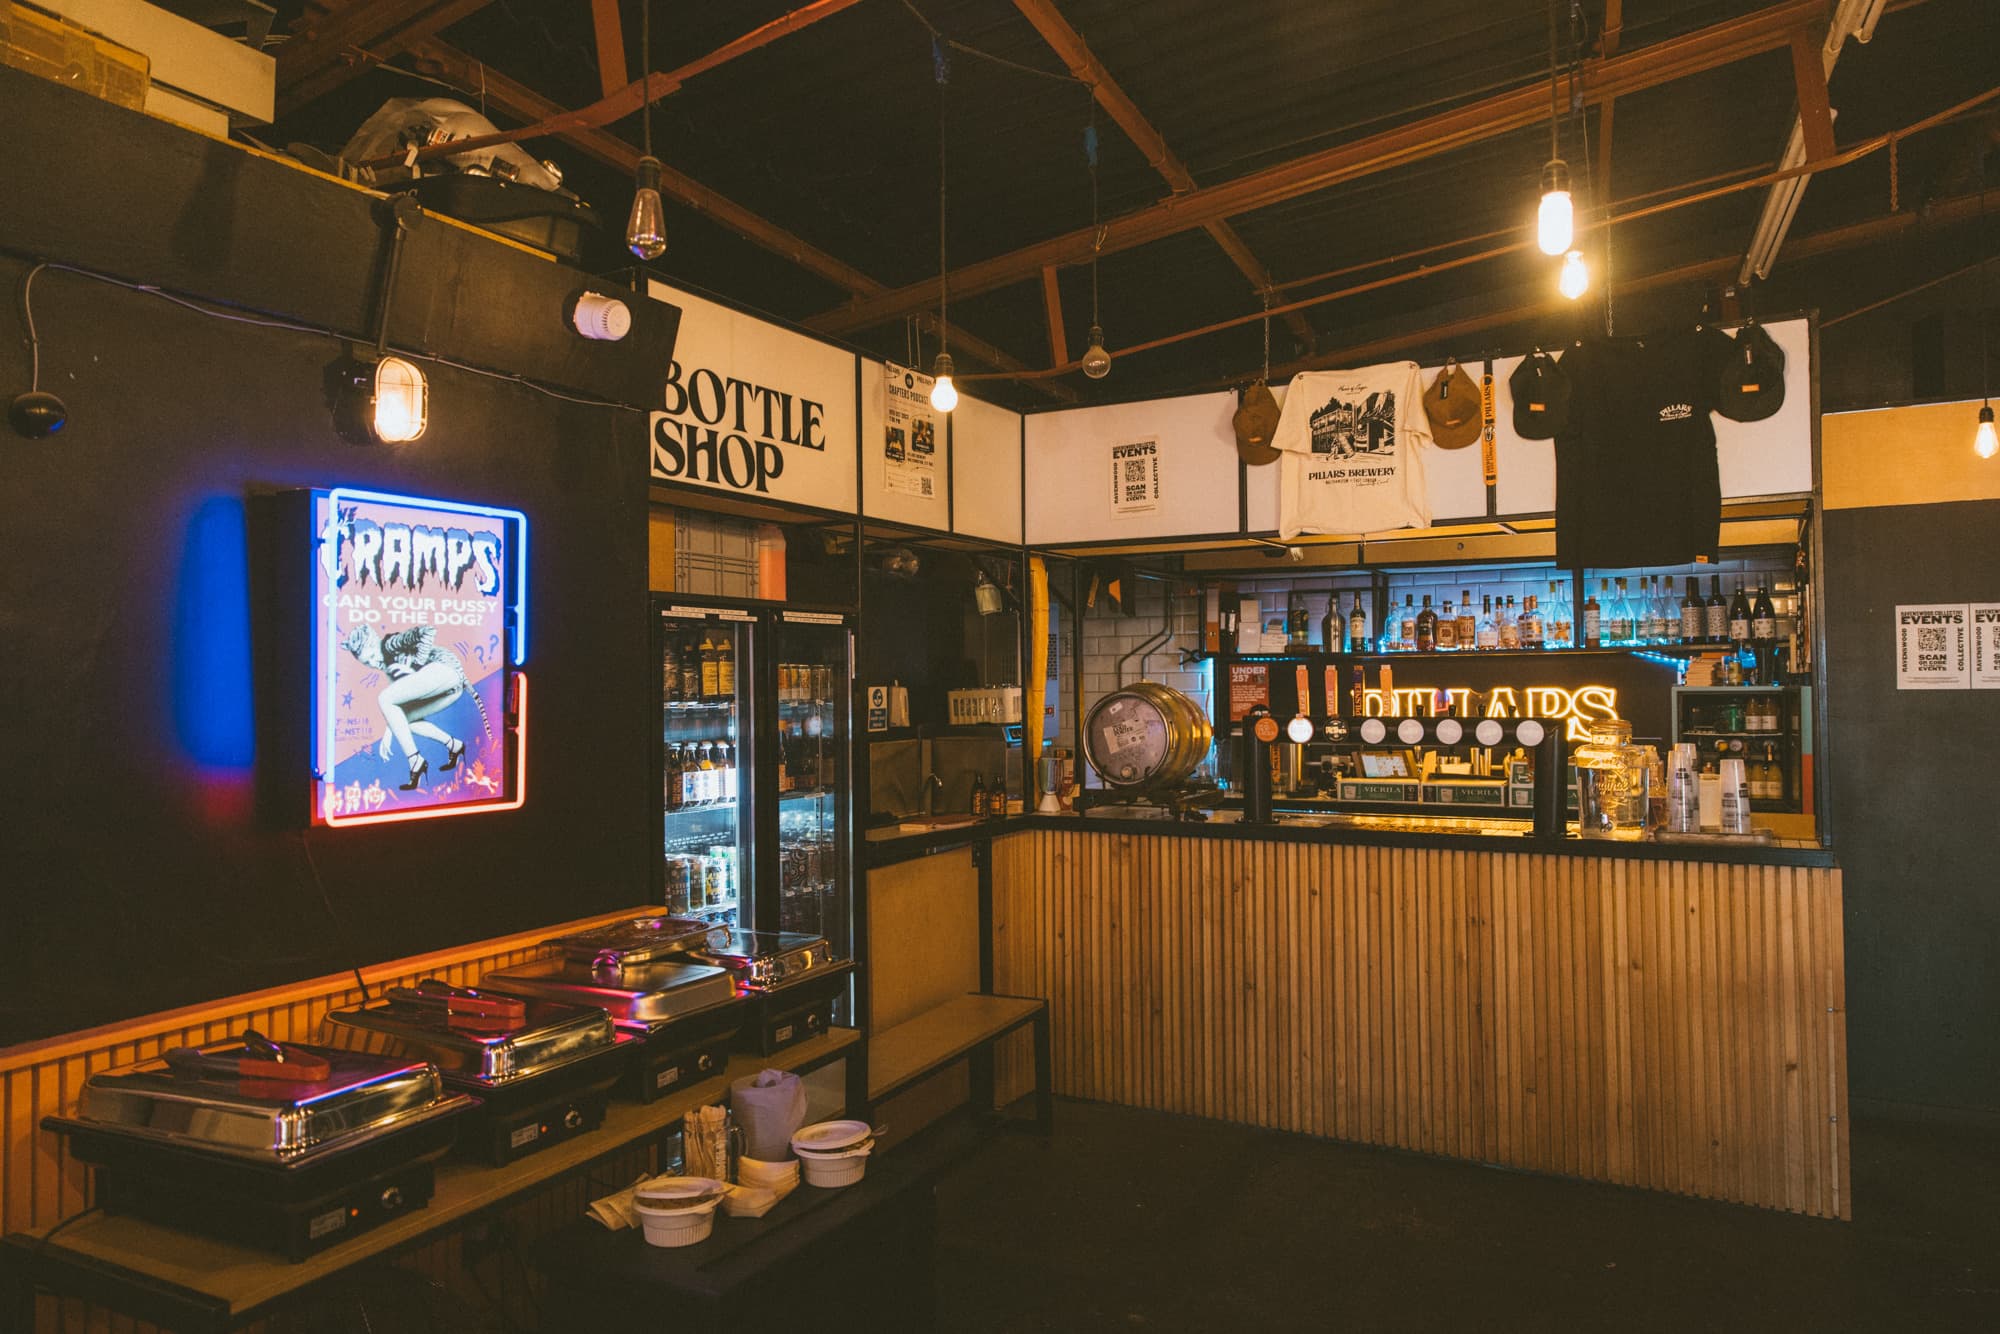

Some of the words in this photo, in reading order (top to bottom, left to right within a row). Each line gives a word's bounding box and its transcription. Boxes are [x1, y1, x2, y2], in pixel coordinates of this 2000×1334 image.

[889, 384, 910, 399] CHAPTERS
[910, 391, 929, 405] PODCAST
[664, 360, 826, 452] BOTTLE
[1660, 404, 1692, 416] PILLARS
[653, 417, 784, 493] SHOP
[1113, 446, 1157, 459] EVENTS
[1308, 469, 1346, 480] PILLARS
[1348, 467, 1397, 477] BREWERY
[1126, 484, 1146, 492] SCAN
[320, 515, 502, 597] CRAMPS
[378, 595, 436, 611] YOUR
[441, 599, 499, 614] PUSSY
[349, 609, 381, 624] DO
[387, 610, 427, 625] THE
[434, 612, 484, 627] DOG?
[1901, 615, 1963, 625] EVENTS
[1460, 788, 1500, 796] VICRILA
